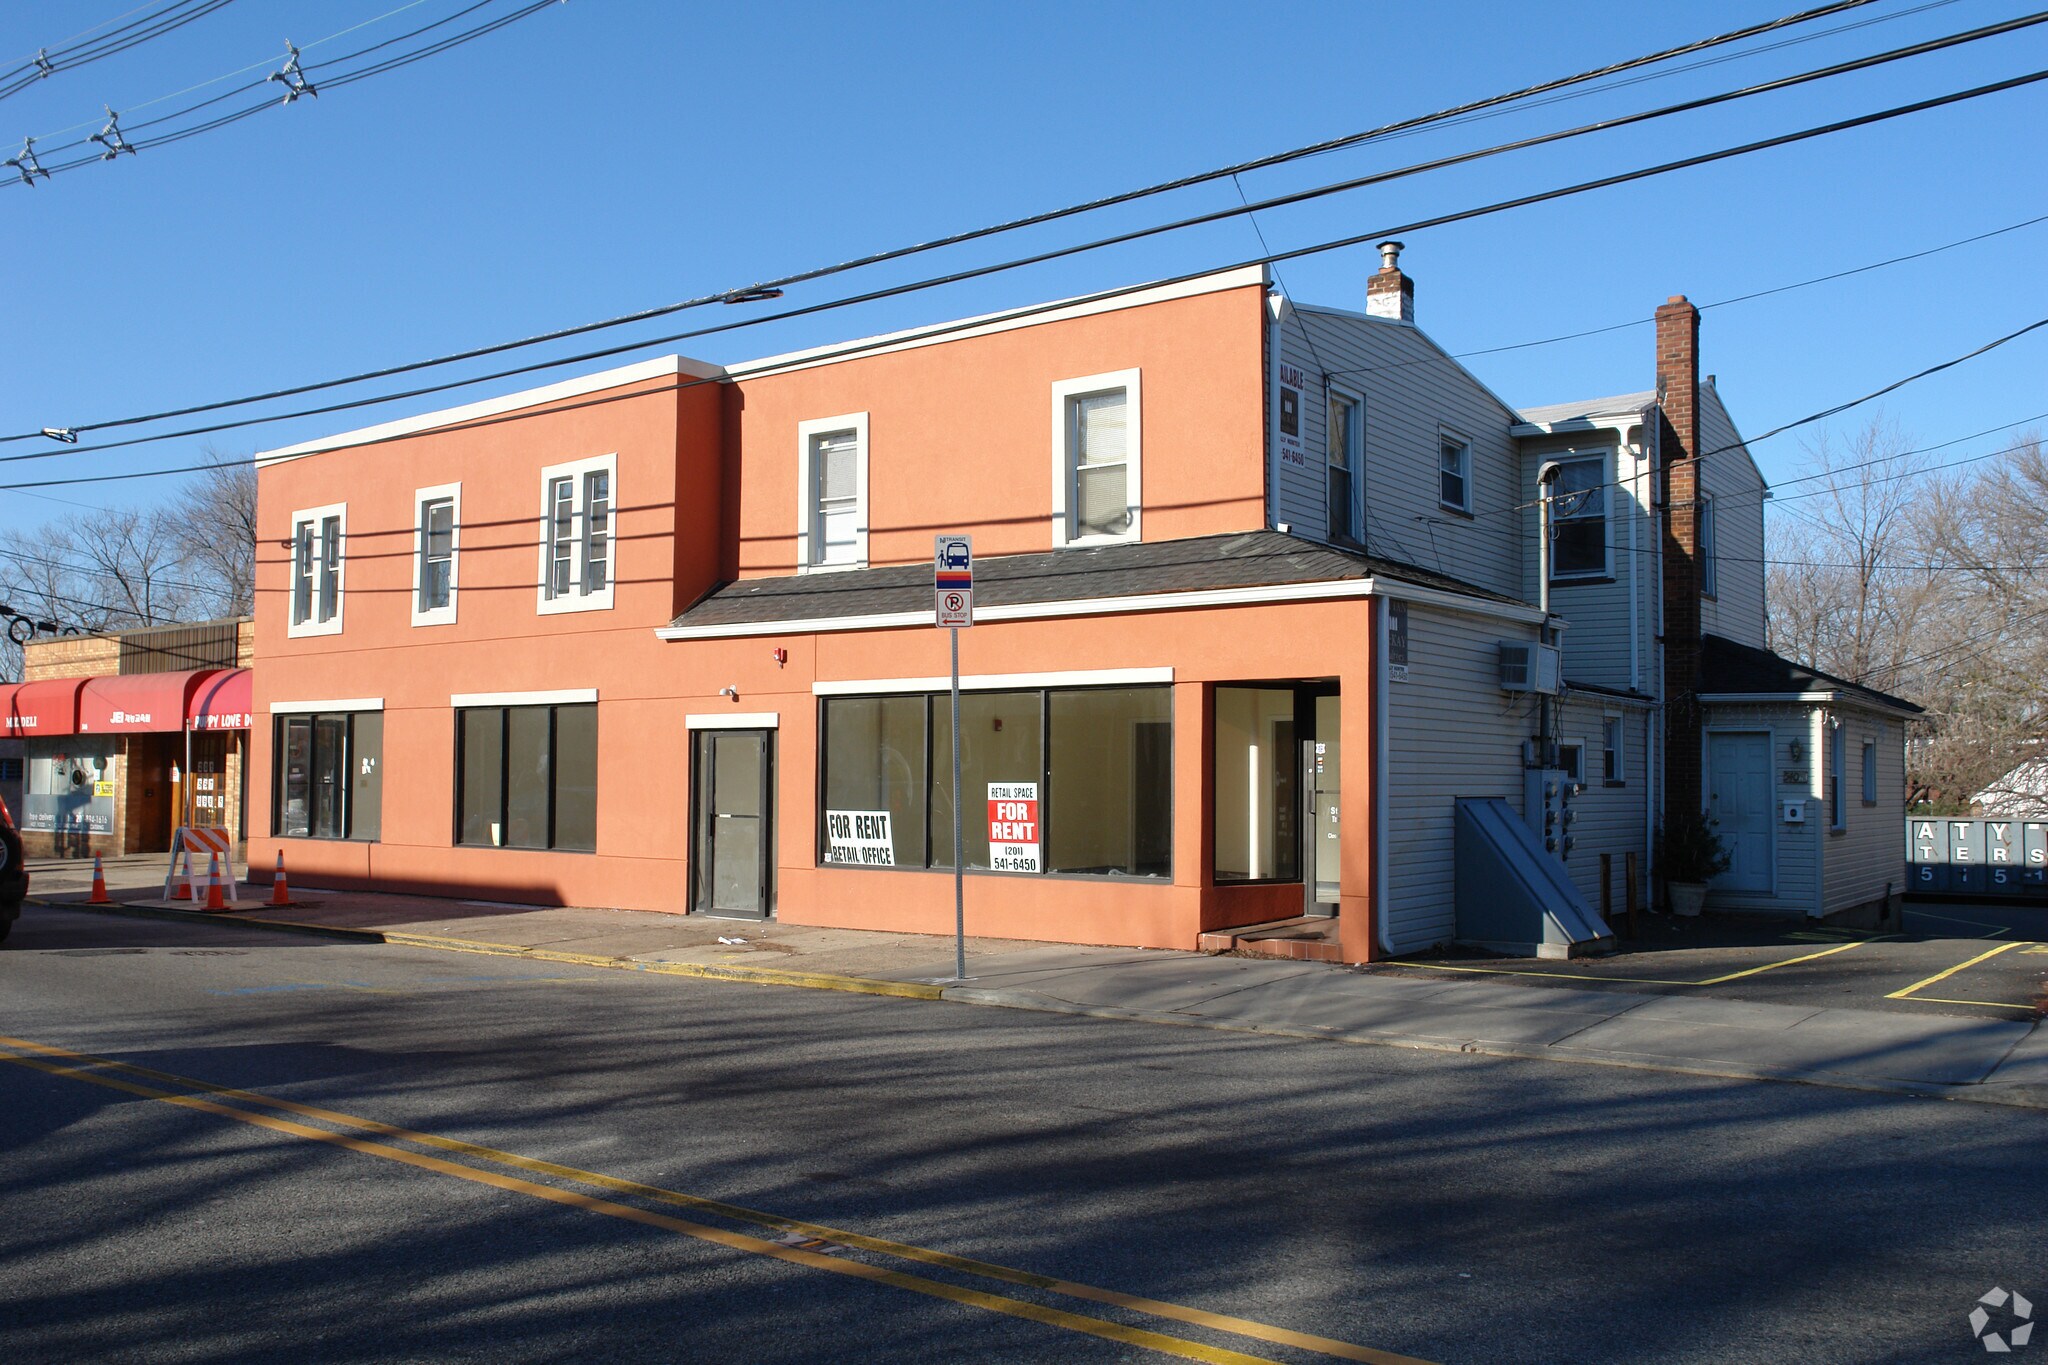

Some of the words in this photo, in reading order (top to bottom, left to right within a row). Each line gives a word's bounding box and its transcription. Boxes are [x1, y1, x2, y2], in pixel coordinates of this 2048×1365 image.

[20, 715, 37, 728] DELI
[194, 714, 219, 729] PUPPY
[221, 713, 242, 728] LOVE
[991, 787, 1011, 799] RETAIL
[1013, 787, 1033, 799] SPACE
[997, 801, 1028, 821] FOR
[829, 814, 851, 839] FOR
[855, 815, 887, 839] RENT
[991, 821, 1035, 841] RENT
[832, 845, 860, 863] RETAIL
[861, 846, 892, 865] OFFICE
[1004, 845, 1024, 856] (201)
[994, 857, 1036, 871] 541-6450
